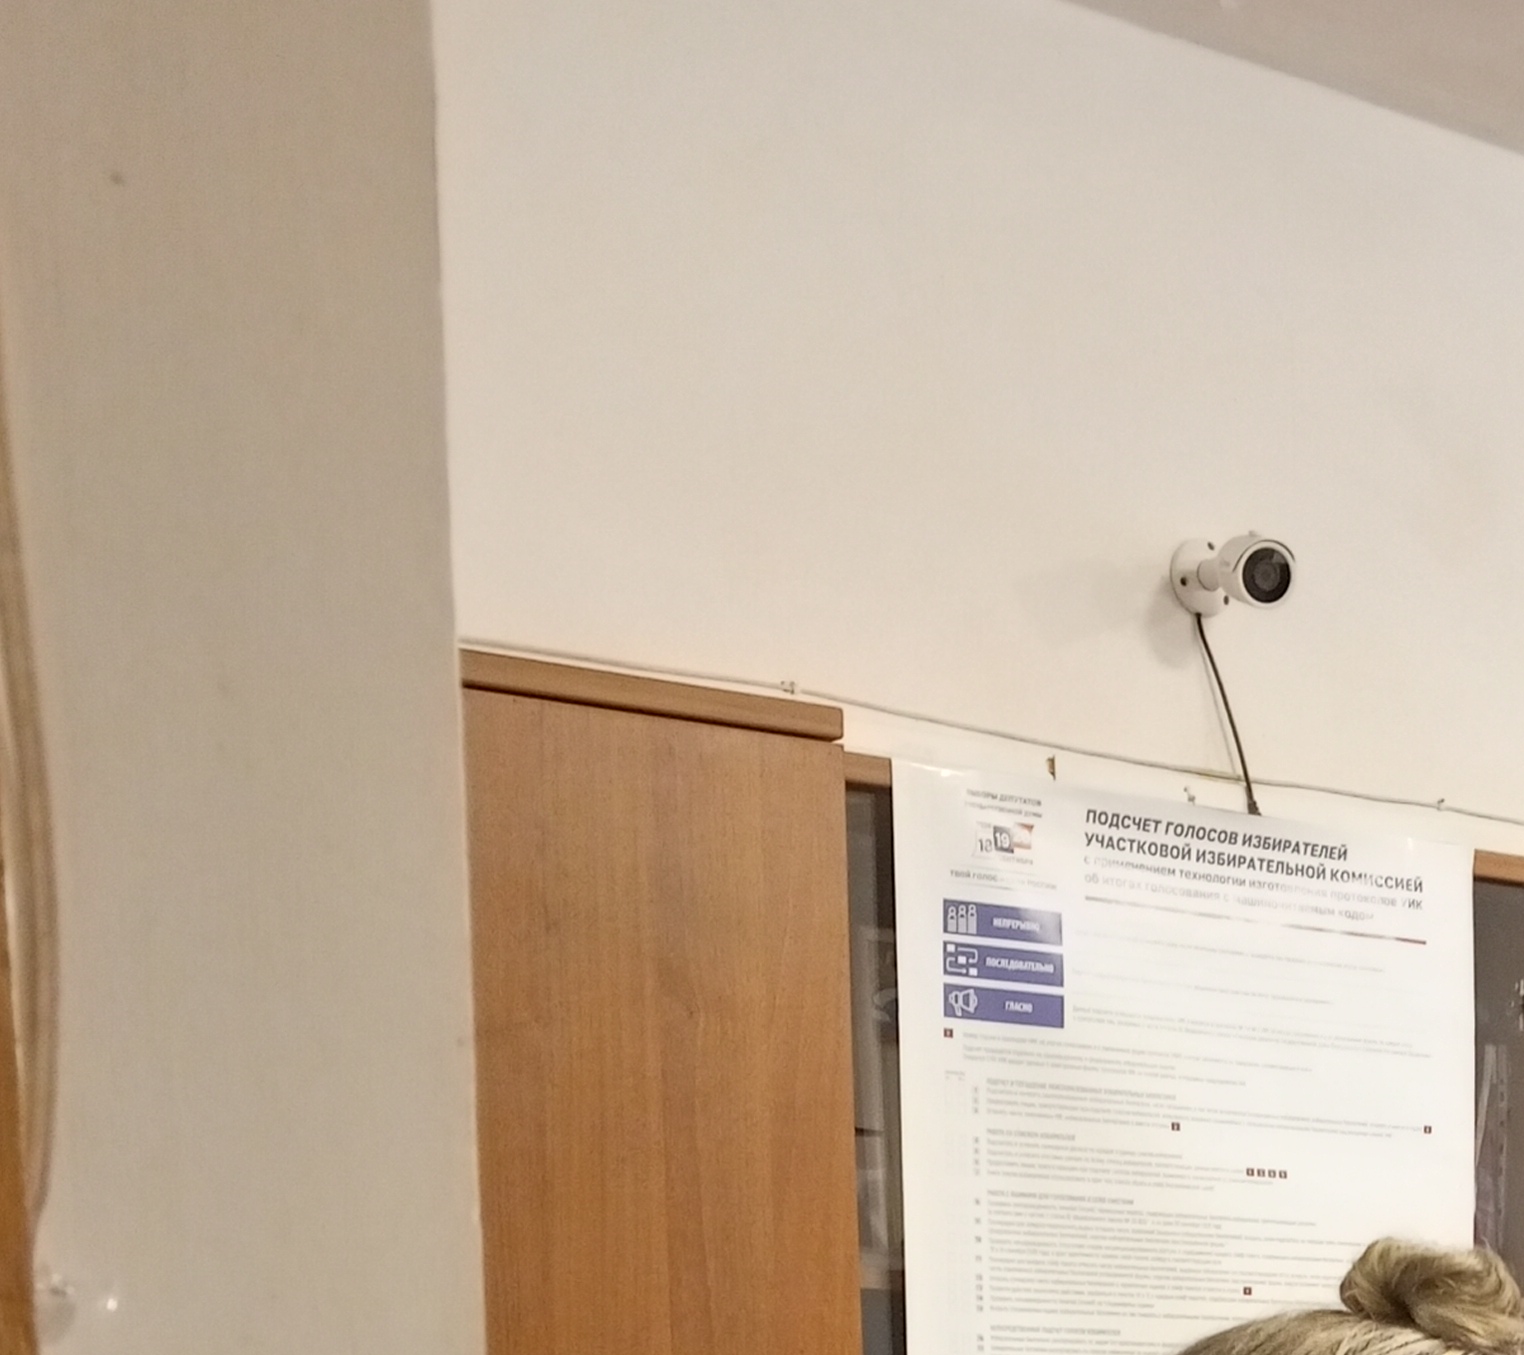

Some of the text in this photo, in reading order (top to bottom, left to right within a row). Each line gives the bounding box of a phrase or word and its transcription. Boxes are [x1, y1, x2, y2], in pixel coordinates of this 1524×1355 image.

[994, 831, 1011, 849] 19
[1085, 809, 1348, 861] ПОДСЧЕТ ГОЛОСОВ ИЗБИРАТЕЛЕЙ
[1084, 832, 1423, 893] УЧАСТКОВОЙ ИЗБИРАТЕЛЬНОЙ КОМИССИЕЙ
[1179, 868, 1246, 887] технологии
[1004, 1001, 1034, 1014] ГЛАСНО
